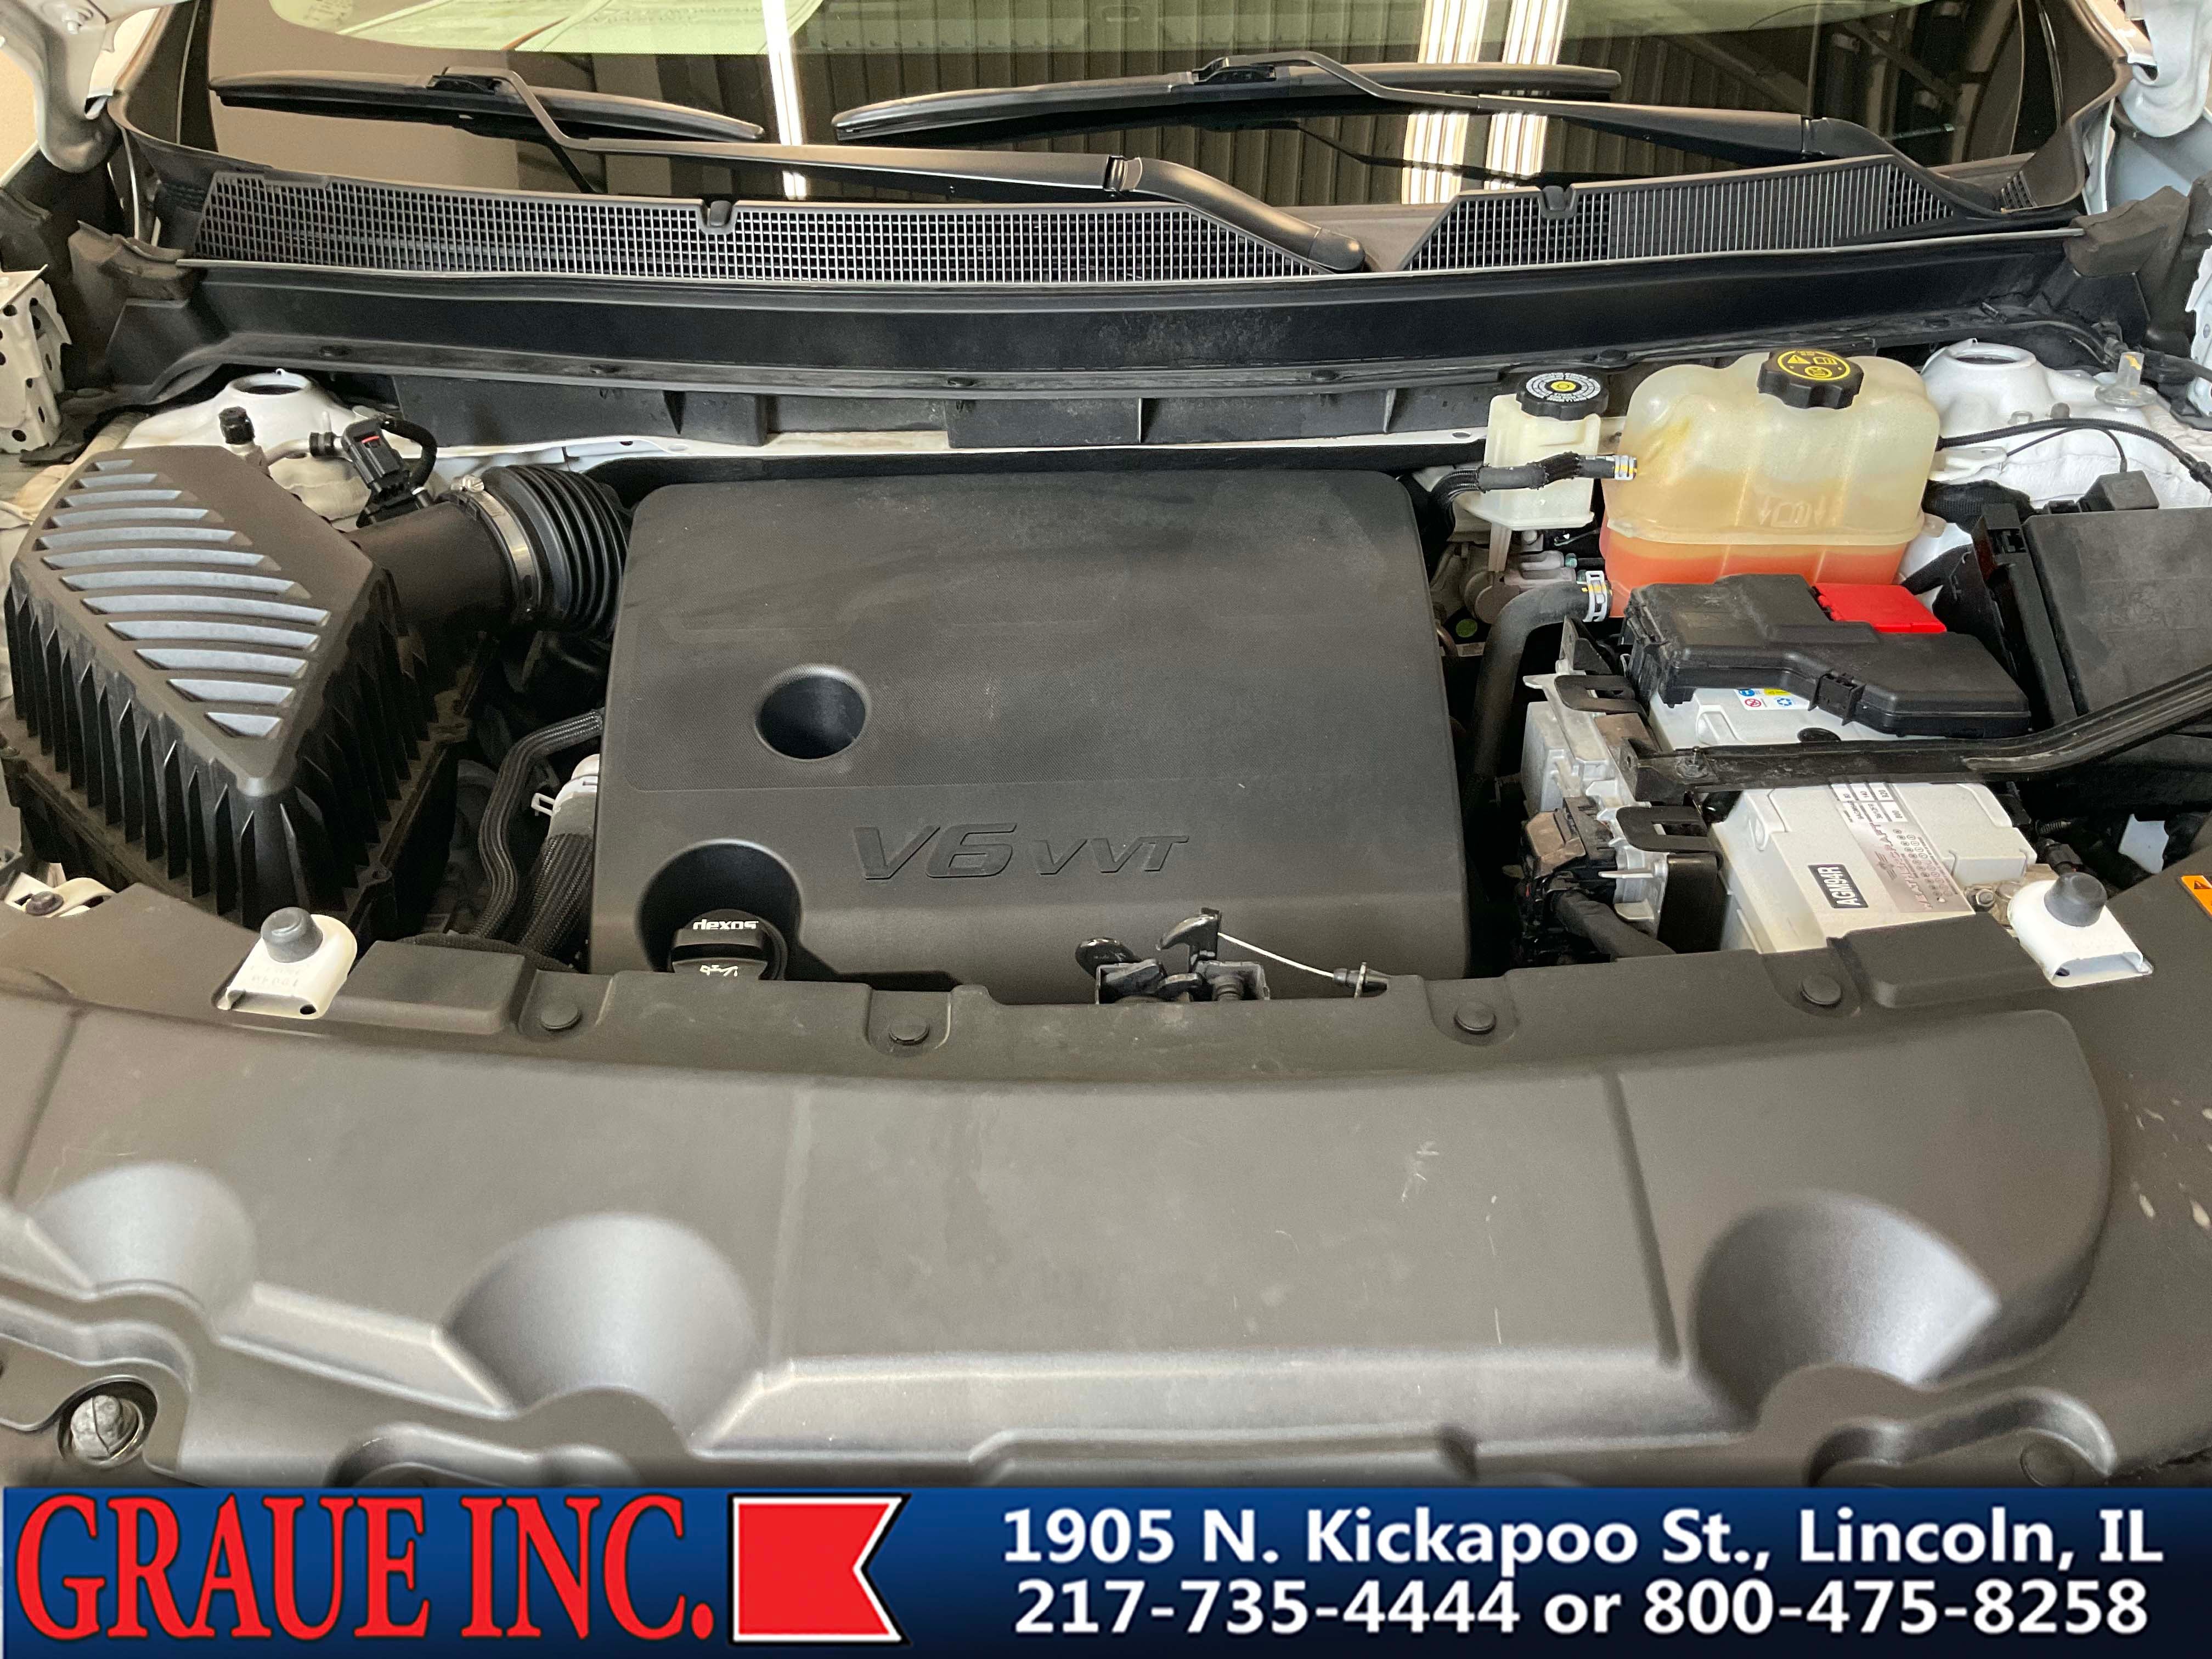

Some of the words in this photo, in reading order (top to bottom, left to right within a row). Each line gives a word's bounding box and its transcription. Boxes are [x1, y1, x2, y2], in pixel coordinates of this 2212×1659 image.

[854, 822, 1018, 880] V6
[1035, 835, 1189, 875] VVT
[1817, 867, 1861, 906] AGM94R
[692, 919, 759, 930] dexos
